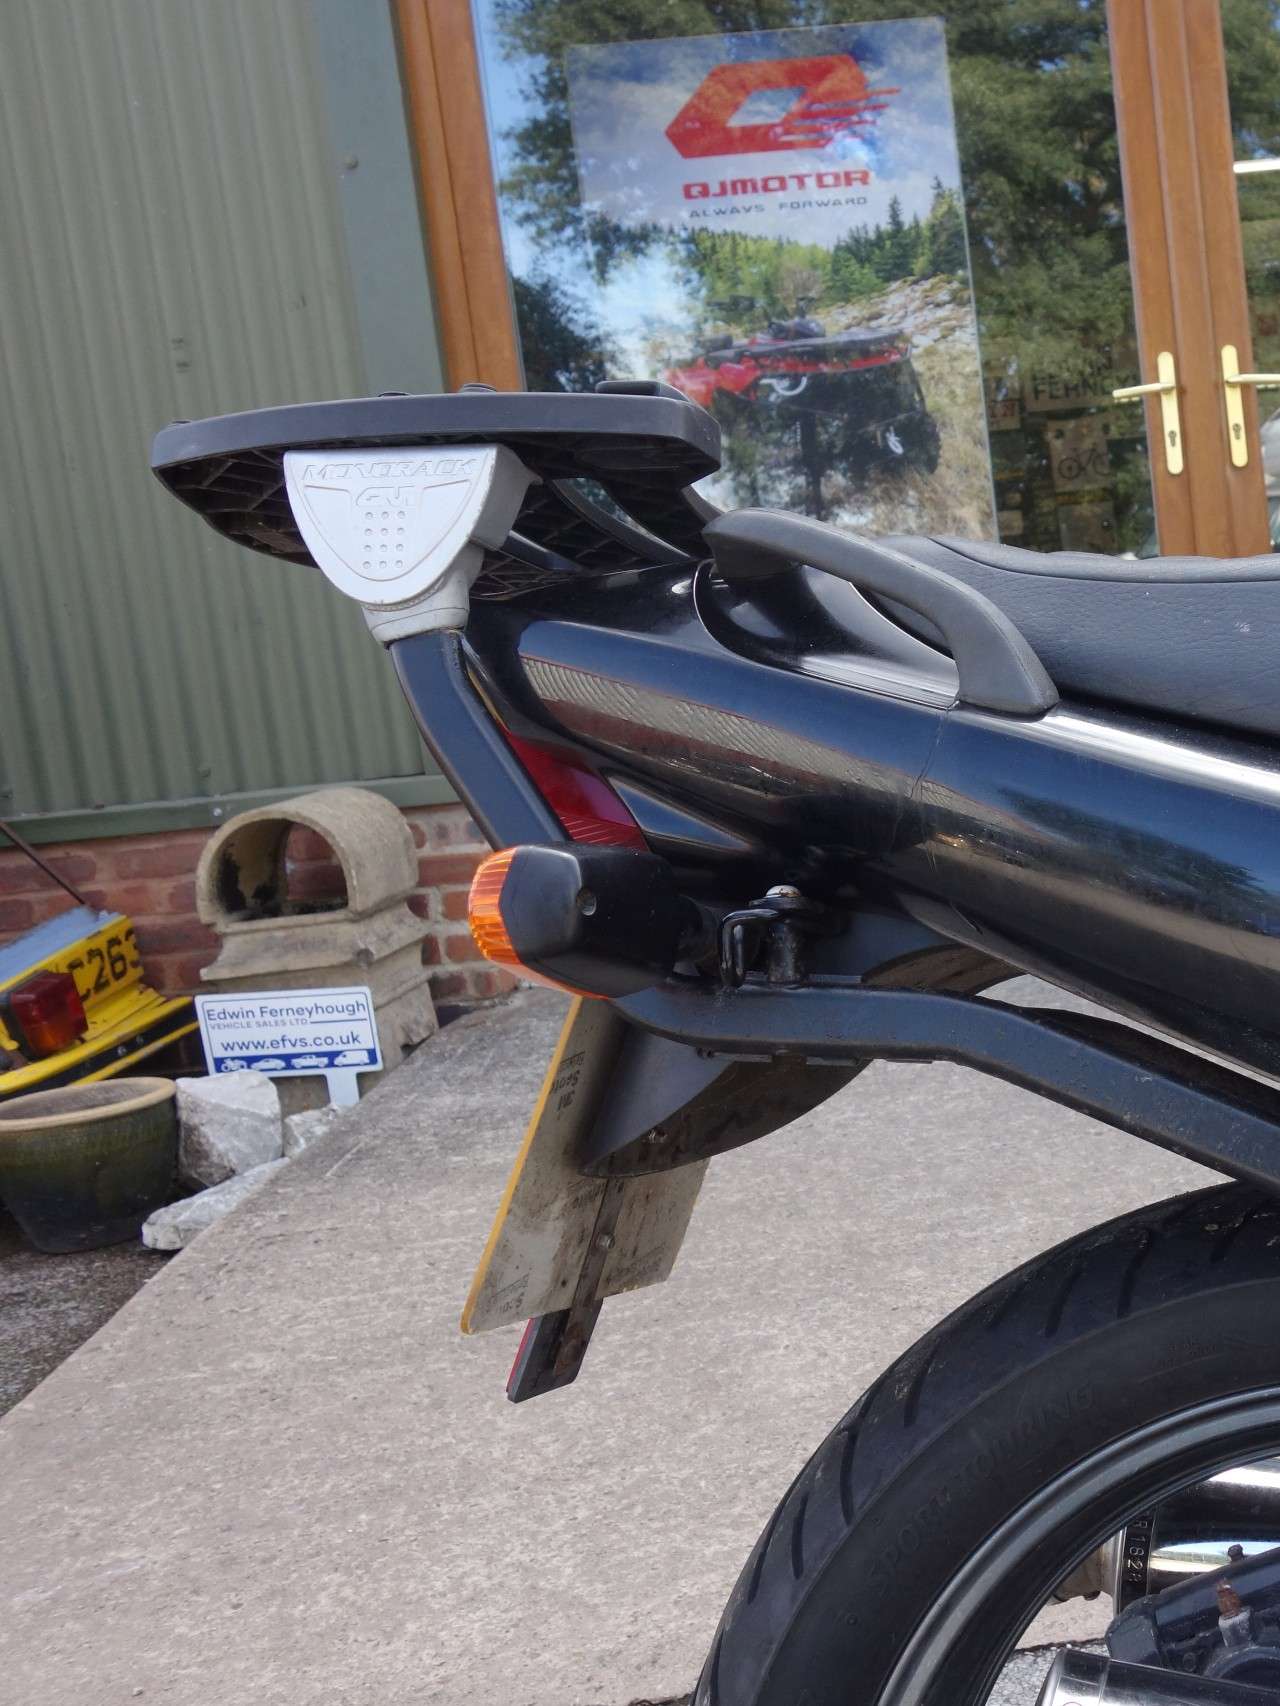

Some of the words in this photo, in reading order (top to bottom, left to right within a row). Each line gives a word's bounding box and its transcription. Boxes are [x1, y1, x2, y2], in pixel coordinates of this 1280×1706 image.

[682, 169, 871, 201] QJMOTOR
[689, 203, 766, 219] ALWAYS
[778, 196, 868, 211] FORWARD
[302, 458, 477, 481] MONORACK
[206, 1006, 255, 1022] Edwin
[259, 1000, 366, 1019] Ferneyhough
[209, 1021, 252, 1031] VEHICLE
[255, 1019, 287, 1029] SALES
[220, 1031, 361, 1052] www.efvs.co.uk
